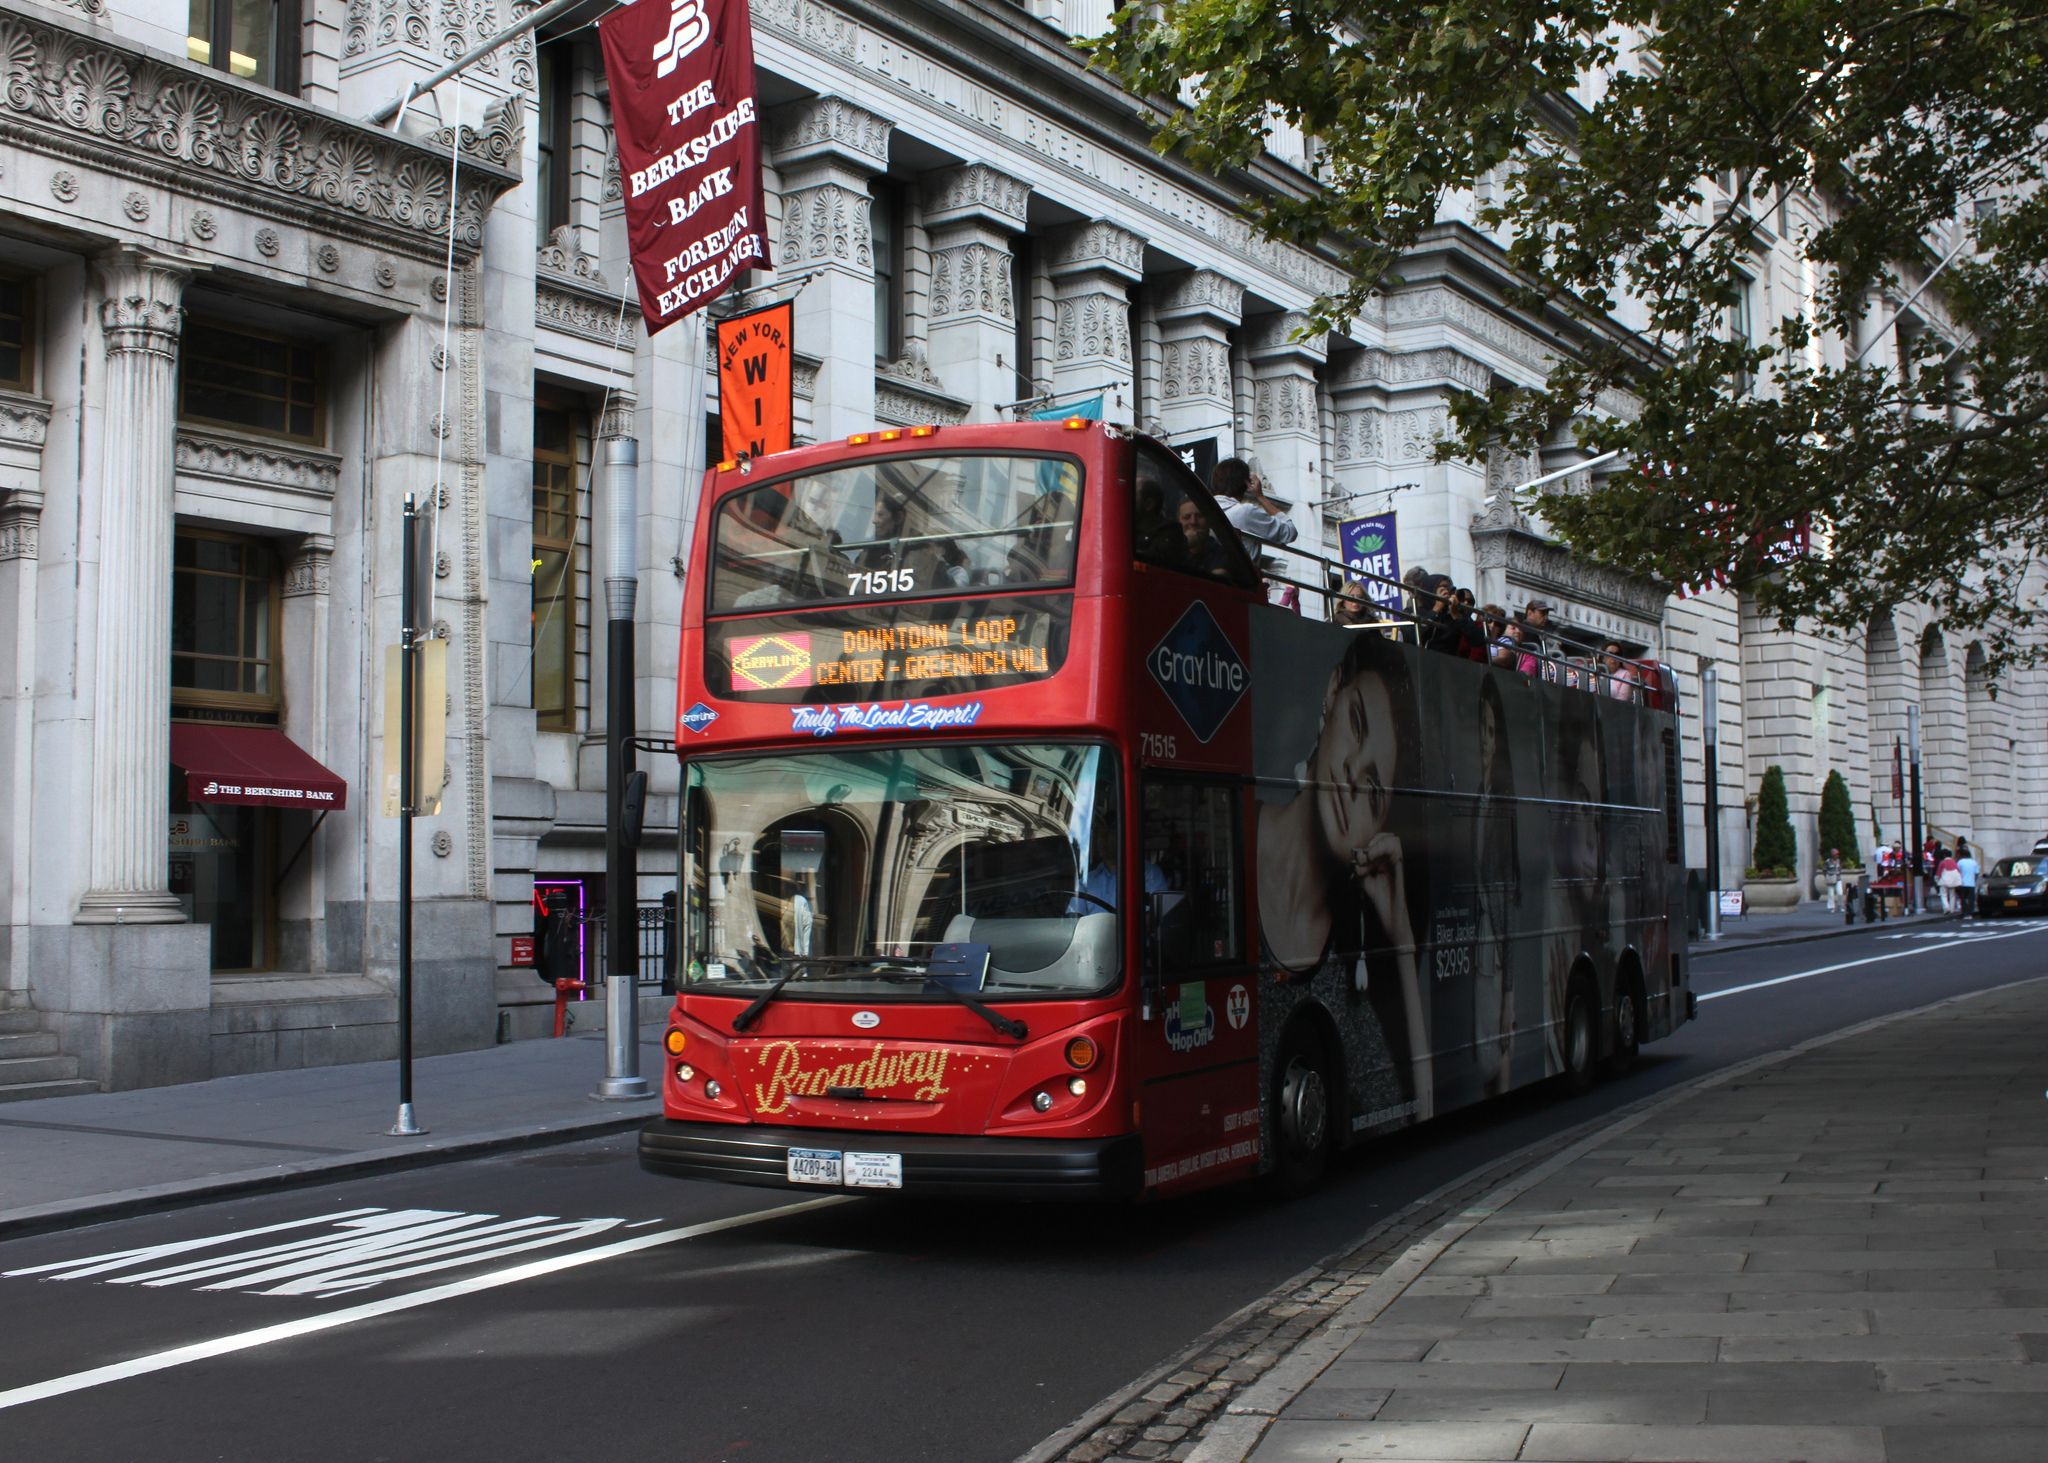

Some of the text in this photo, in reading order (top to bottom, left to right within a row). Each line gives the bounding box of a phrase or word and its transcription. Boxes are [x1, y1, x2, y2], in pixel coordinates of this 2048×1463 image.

[667, 79, 716, 126] THE
[667, 166, 733, 226] BANK
[663, 205, 748, 283] FOREIGN
[656, 233, 763, 317] EXCHANGE
[723, 328, 747, 372] NEW
[848, 568, 914, 596] 71515
[1350, 553, 1392, 581] CAFE
[961, 619, 1016, 645] LOOP
[816, 659, 885, 685] CENTER
[905, 650, 1007, 680] GREENWICH
[1157, 646, 1243, 692] Gray Line
[791, 702, 981, 737] Truly, The Local Expert!
[1140, 732, 1176, 759] 71515
[219, 785, 334, 800] THE BERKSHIRE BANK
[1436, 946, 1470, 981] $29.95
[1172, 1032, 1193, 1053] Hop
[755, 1040, 950, 1114] Broadway
[862, 1167, 883, 1177] 2244
